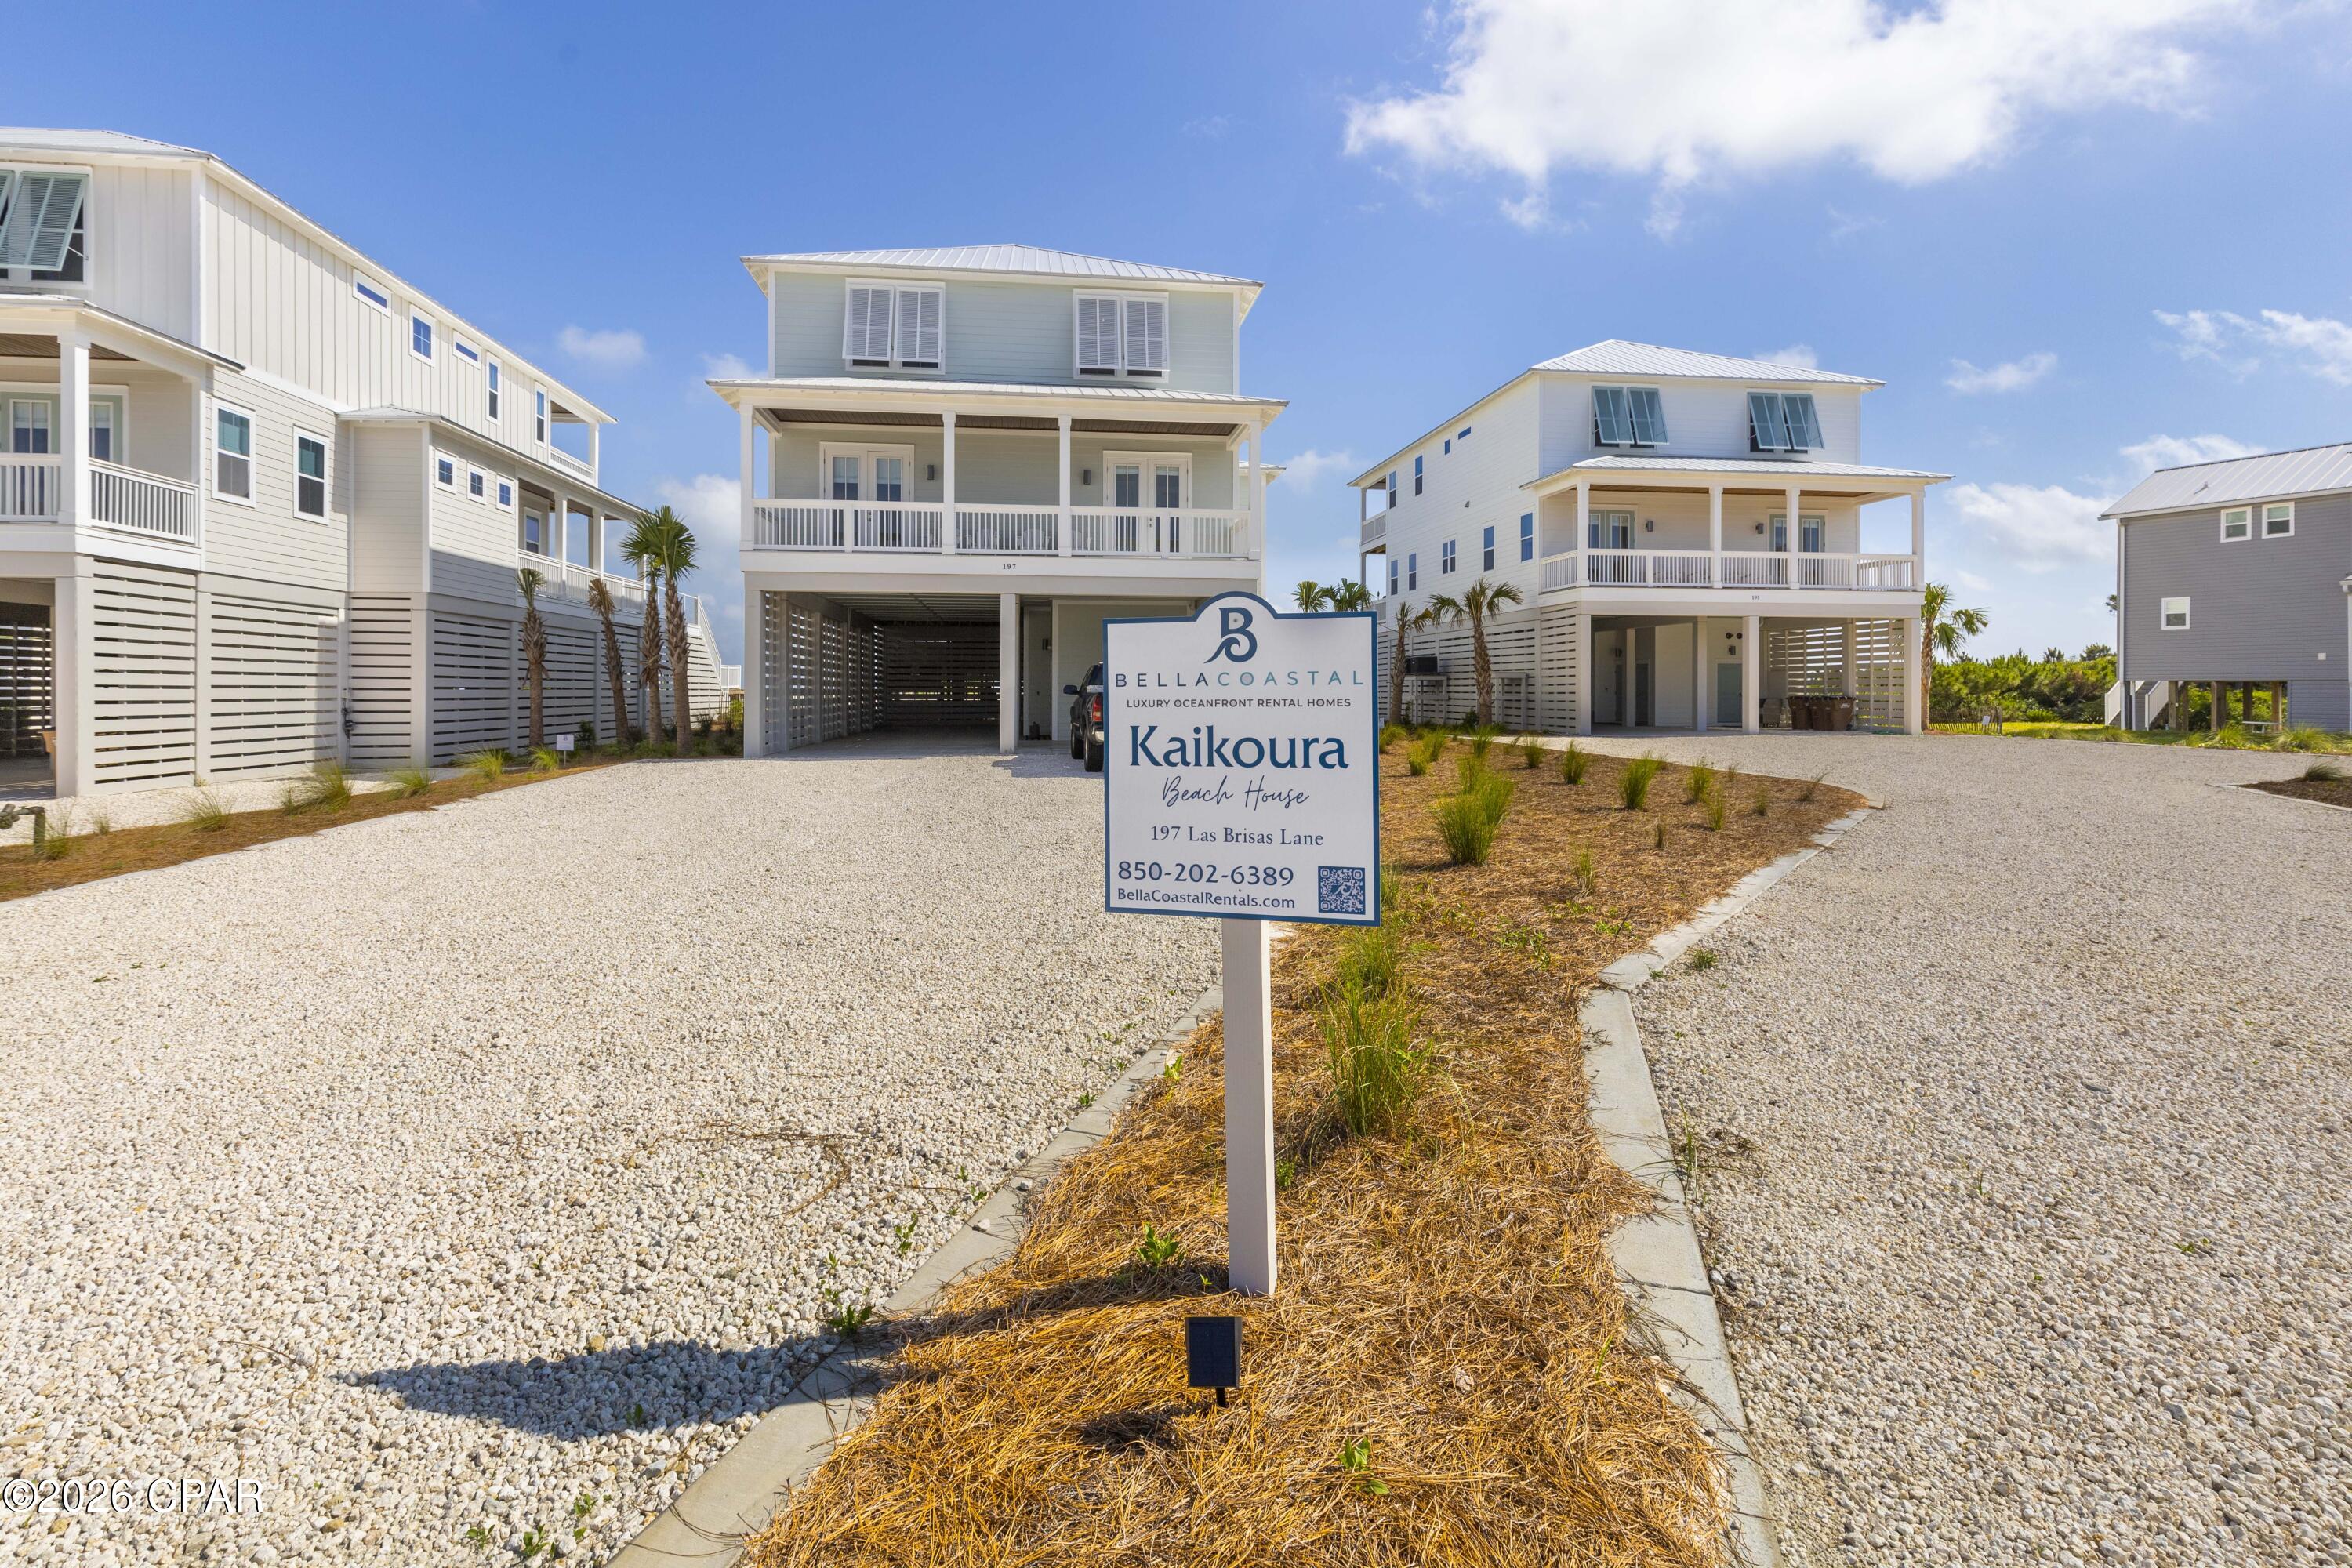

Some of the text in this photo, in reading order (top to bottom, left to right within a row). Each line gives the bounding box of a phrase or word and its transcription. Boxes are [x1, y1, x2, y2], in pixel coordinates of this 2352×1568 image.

[1127, 698, 1352, 708] LUXURY OCEANFRONT RENTAL HOMES
[1129, 724, 1350, 770] Kaikoura
[1161, 775, 1311, 811] Beach House
[1150, 825, 1324, 846] 197 Las Brisas Lane
[1117, 860, 1294, 887] 850-202-6389
[1116, 887, 1296, 909] BellaCoastalRentals.com
